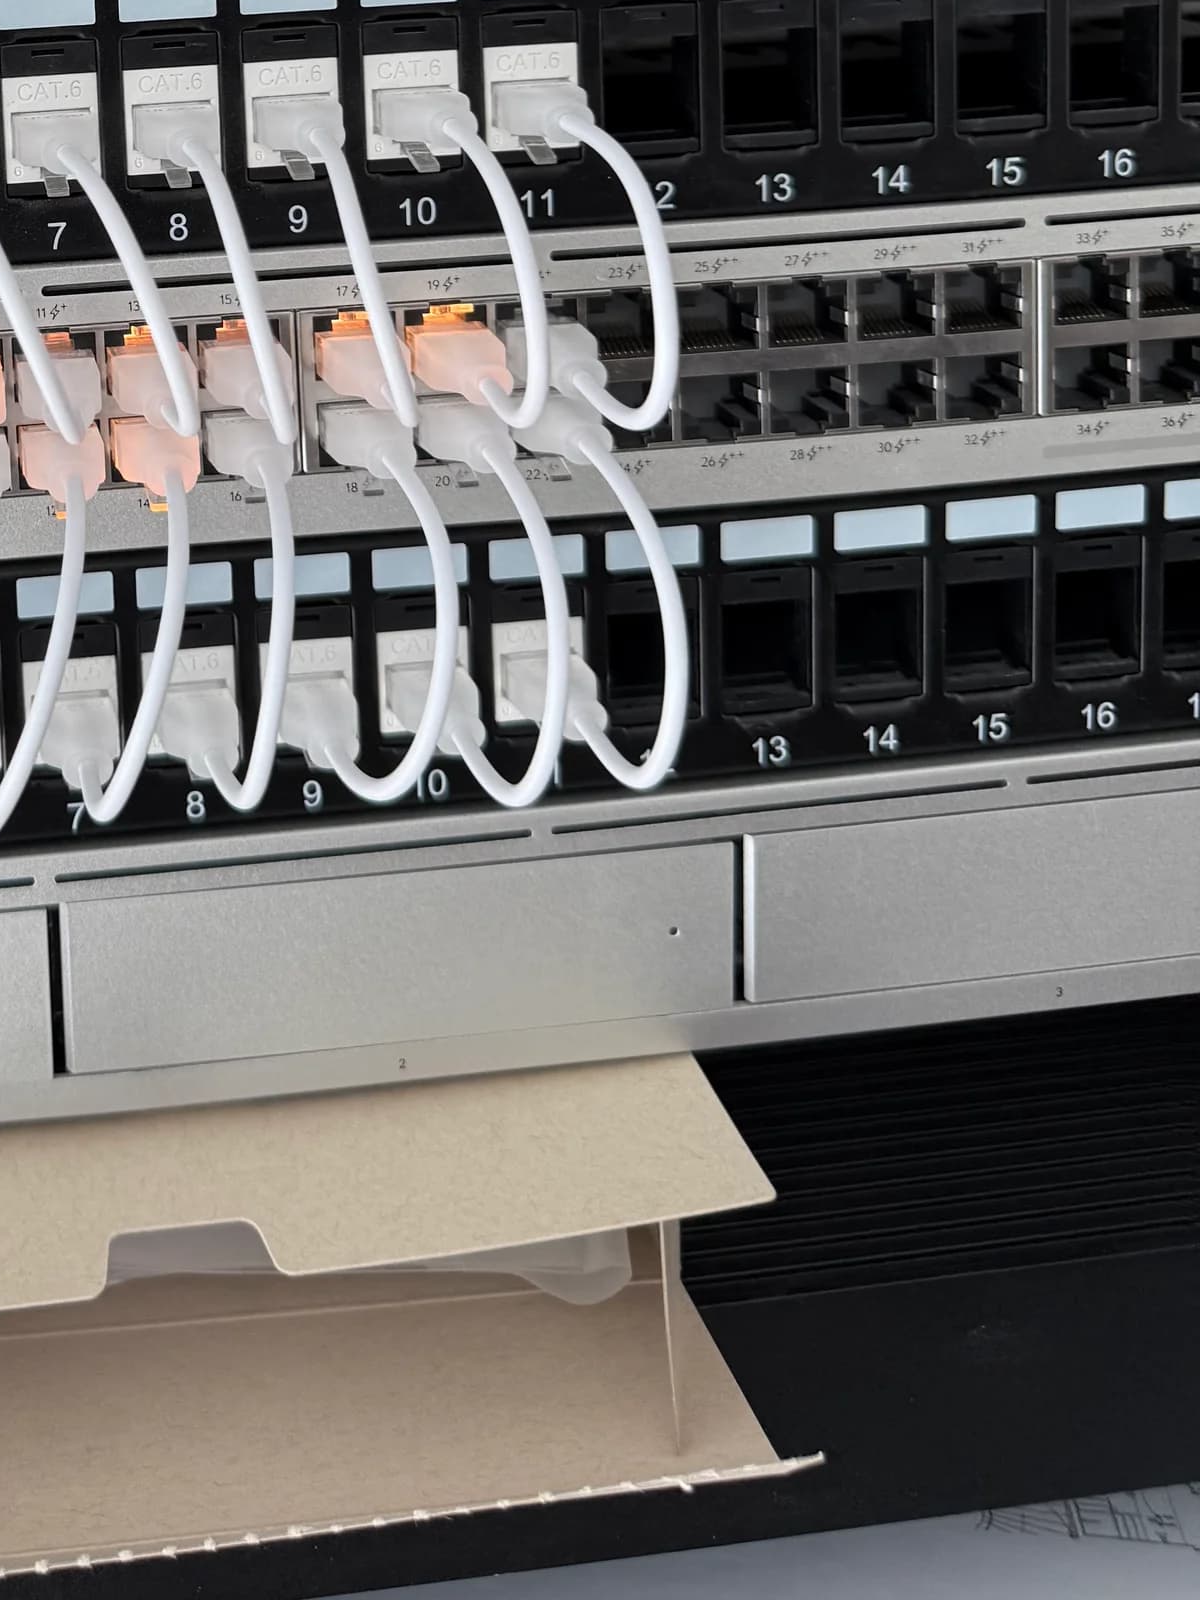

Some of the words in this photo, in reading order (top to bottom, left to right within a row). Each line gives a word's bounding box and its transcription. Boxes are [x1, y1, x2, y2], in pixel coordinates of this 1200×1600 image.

[985, 156, 1023, 186] 15
[1097, 148, 1134, 177] 16
[755, 173, 793, 202] 13
[871, 164, 909, 194] 14
[399, 196, 437, 226] 10
[520, 188, 553, 218] 11
[169, 213, 189, 241] 8
[288, 204, 308, 233] 9
[47, 221, 67, 251] 7
[972, 712, 1008, 741] 15
[1081, 701, 1115, 730] 16
[751, 735, 788, 765] 13
[863, 723, 899, 753] 14
[186, 790, 205, 818] 8
[302, 779, 322, 808] 9
[67, 802, 86, 832] 7
